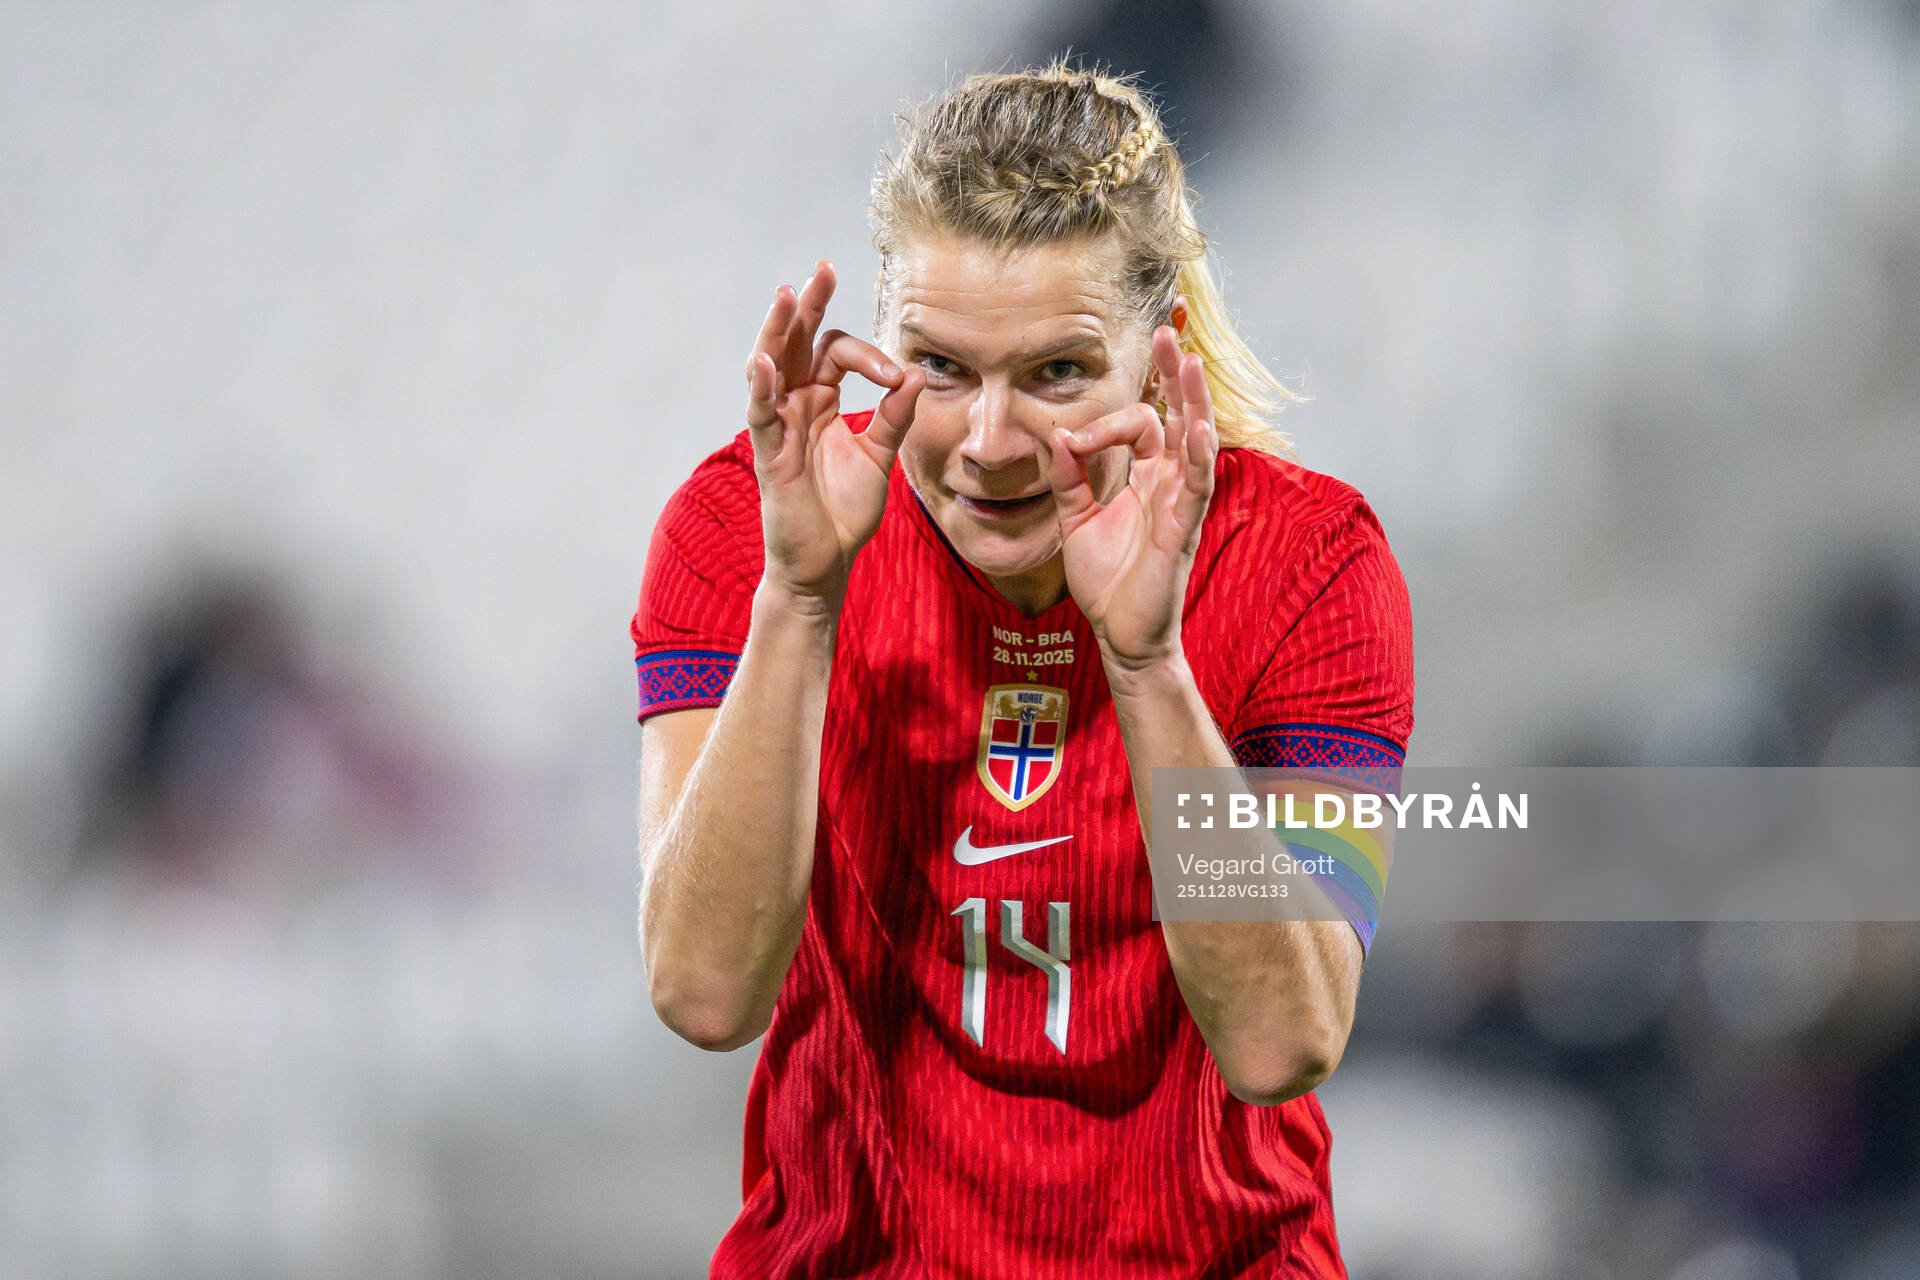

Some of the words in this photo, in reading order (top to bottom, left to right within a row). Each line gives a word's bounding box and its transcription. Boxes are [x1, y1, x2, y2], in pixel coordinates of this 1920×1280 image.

[993, 625, 1022, 646] NOR
[1038, 630, 1074, 646] BRA
[993, 646, 1074, 666] 28.11.2025
[1017, 692, 1043, 704] NORGE
[950, 897, 1071, 1056] 14
